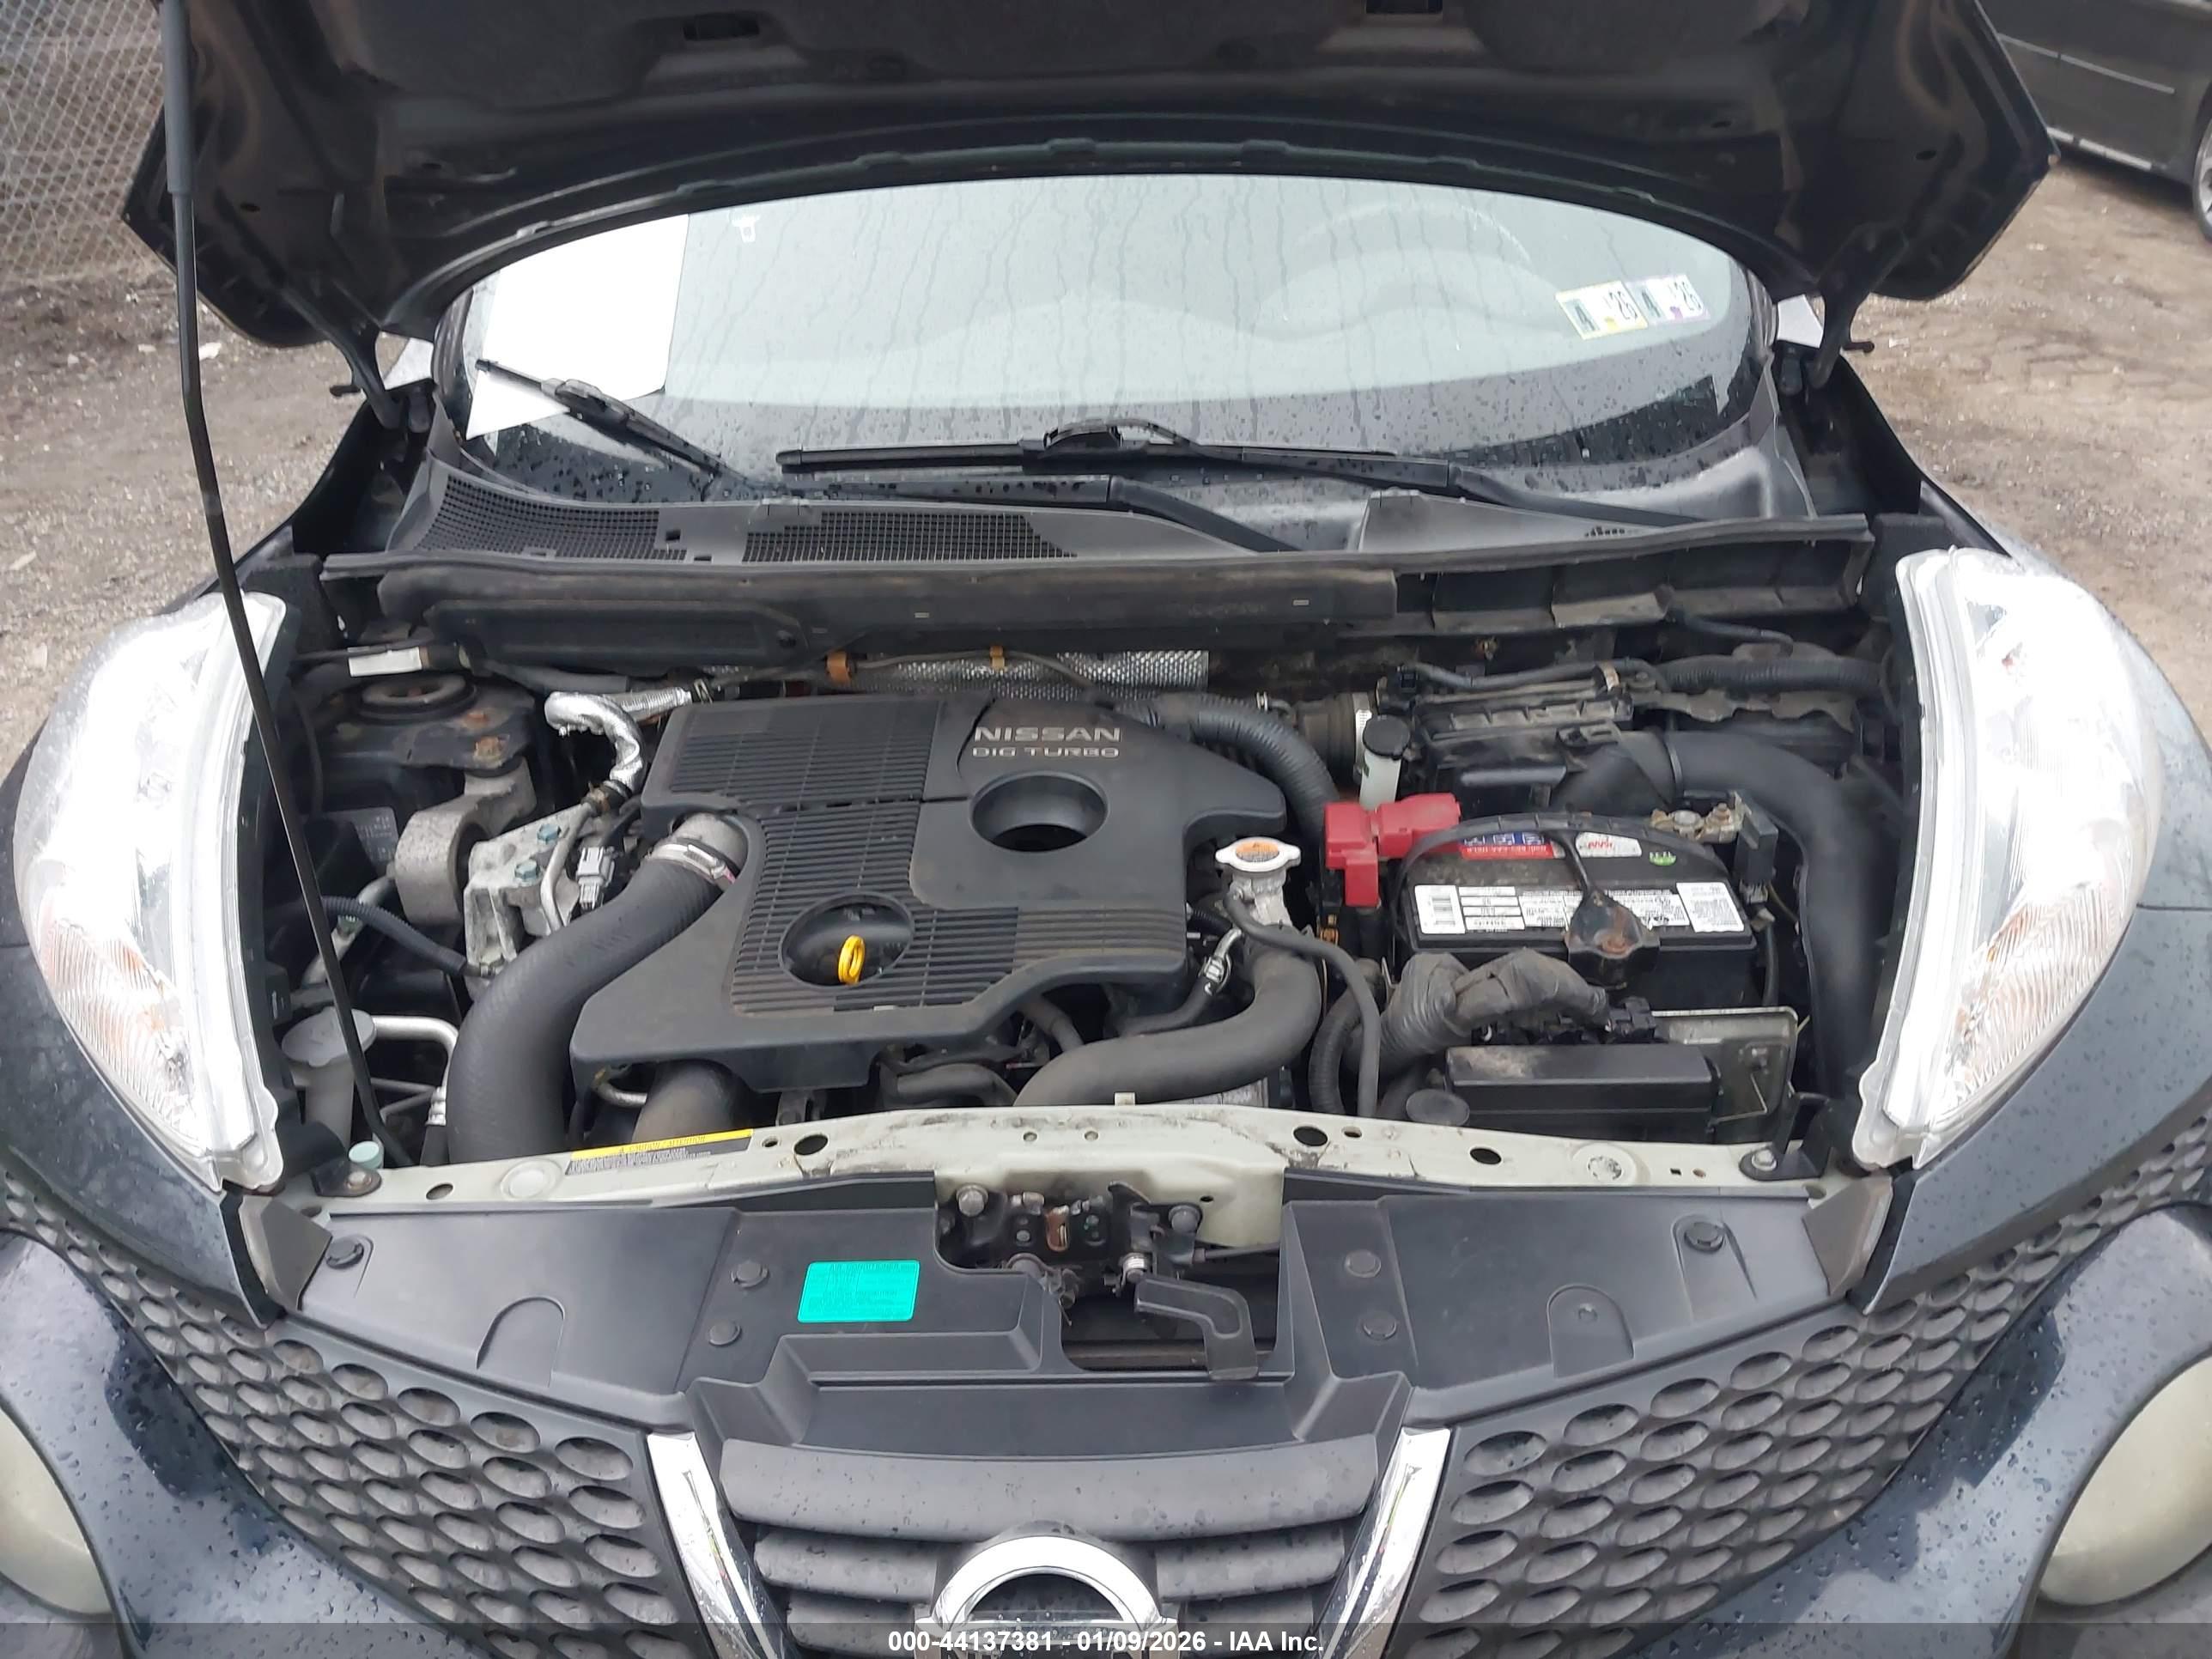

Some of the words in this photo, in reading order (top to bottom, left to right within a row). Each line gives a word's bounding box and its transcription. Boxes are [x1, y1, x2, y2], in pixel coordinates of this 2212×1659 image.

[974, 727, 1121, 742] NISSAN
[972, 747, 1017, 757] DIG
[1024, 747, 1120, 757] TURBO
